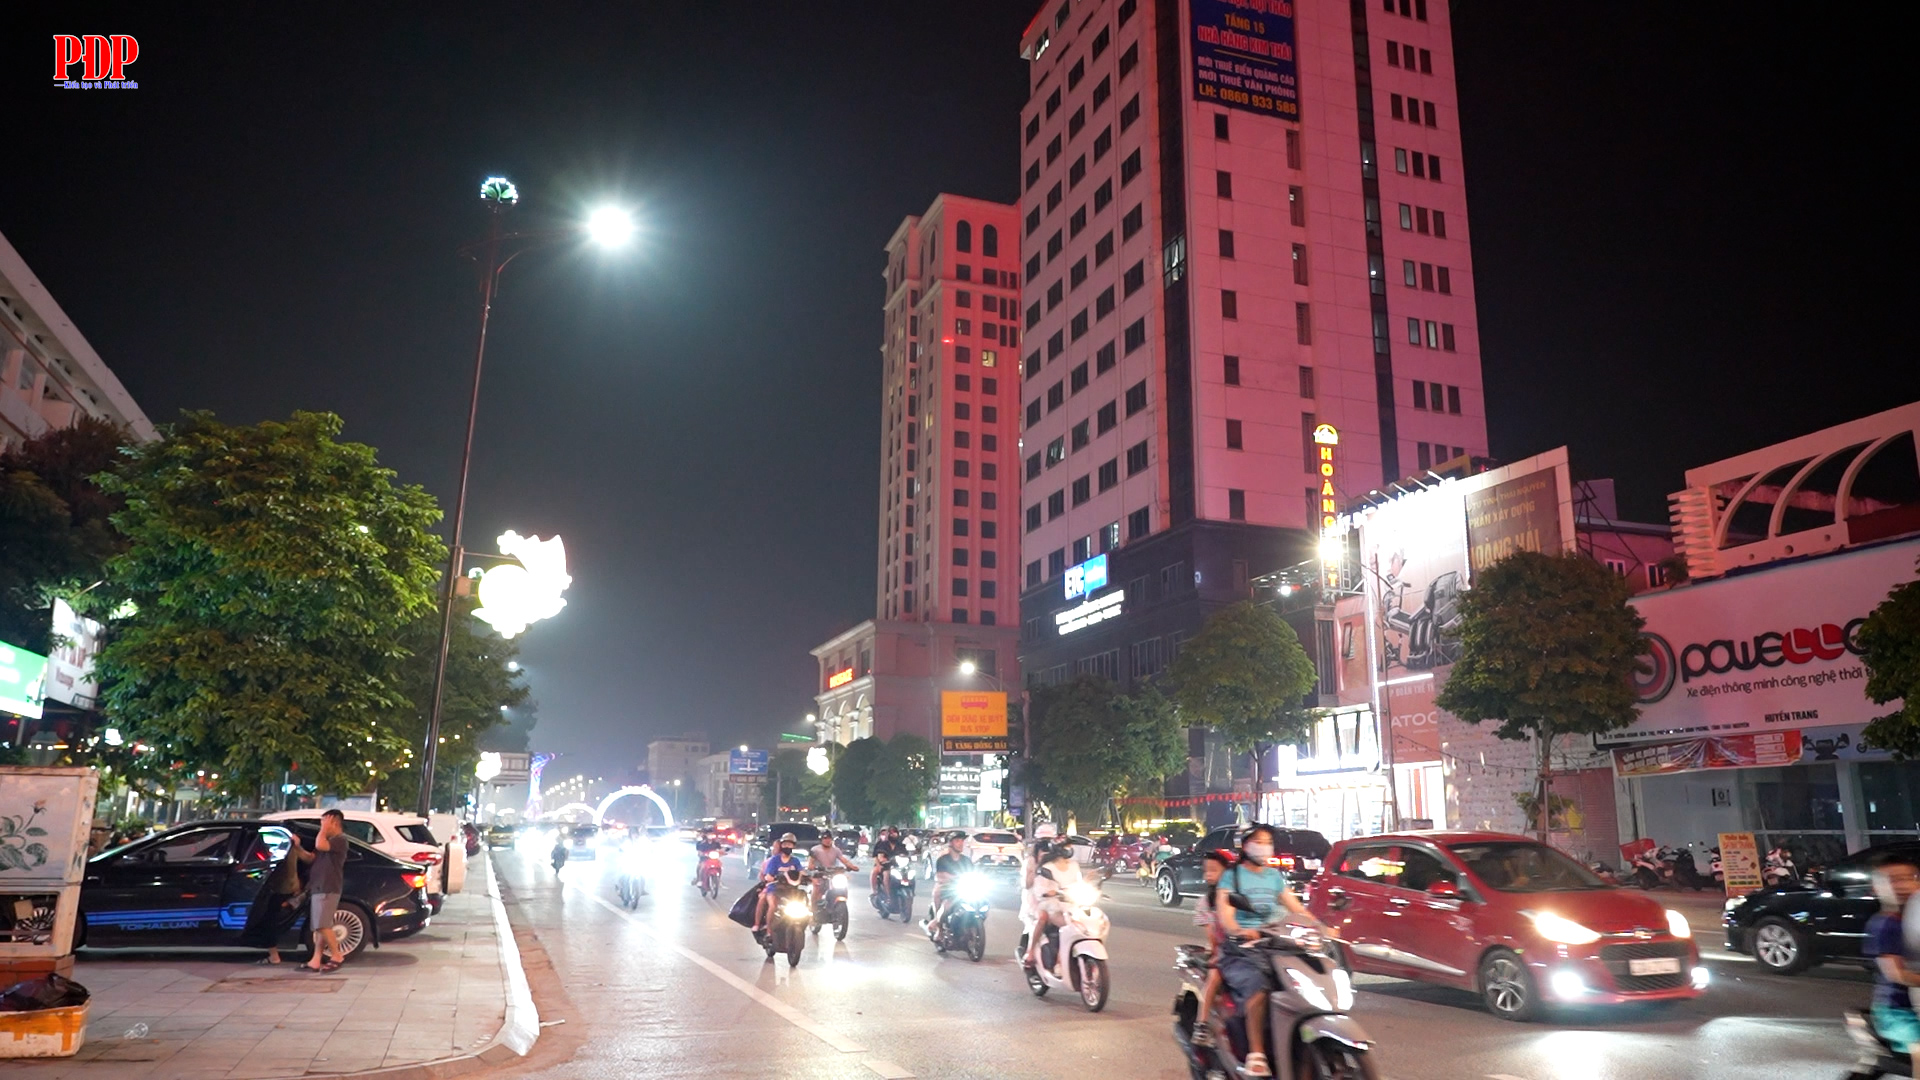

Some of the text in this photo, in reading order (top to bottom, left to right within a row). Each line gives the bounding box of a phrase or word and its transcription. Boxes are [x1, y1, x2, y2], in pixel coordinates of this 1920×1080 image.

[1254, 21, 1265, 34] 15
[1197, 25, 1292, 61] NHÀ HÀNG KIM THÁI
[1199, 83, 1217, 98] LH:
[1220, 88, 1248, 105] 0869
[1252, 95, 1273, 110] 933
[1687, 688, 1698, 698] Xe
[1700, 684, 1721, 697] điện
[1722, 680, 1752, 694] thông
[1754, 676, 1779, 690] minh
[1781, 674, 1806, 688] công
[1808, 669, 1836, 685] nghệ
[1838, 666, 1863, 679] thời
[1791, 709, 1818, 720] TRANG
